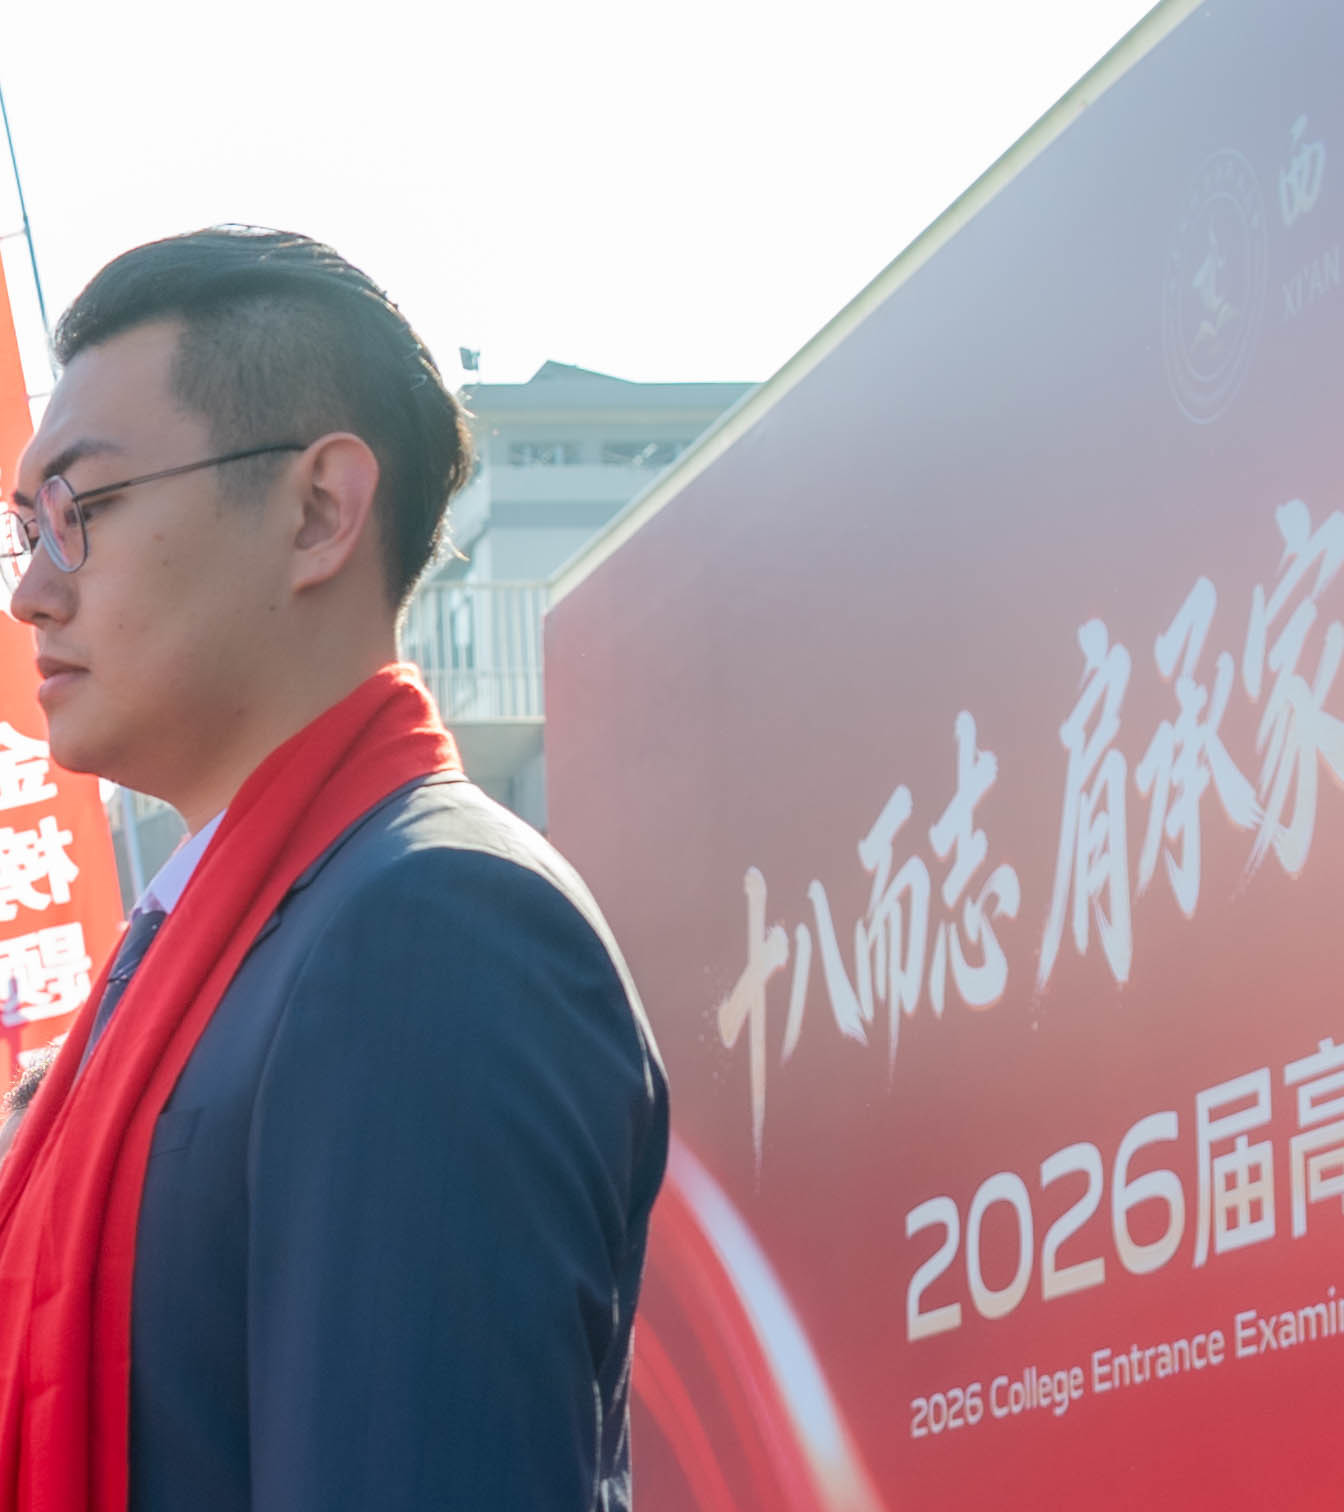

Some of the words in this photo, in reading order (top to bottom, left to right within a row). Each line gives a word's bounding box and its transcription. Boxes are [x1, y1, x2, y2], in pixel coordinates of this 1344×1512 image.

[911, 1382, 983, 1438] 2026
[990, 1366, 1084, 1416] College
[1092, 1329, 1225, 1392] Entrance
[1235, 1286, 1344, 1358] Exami
